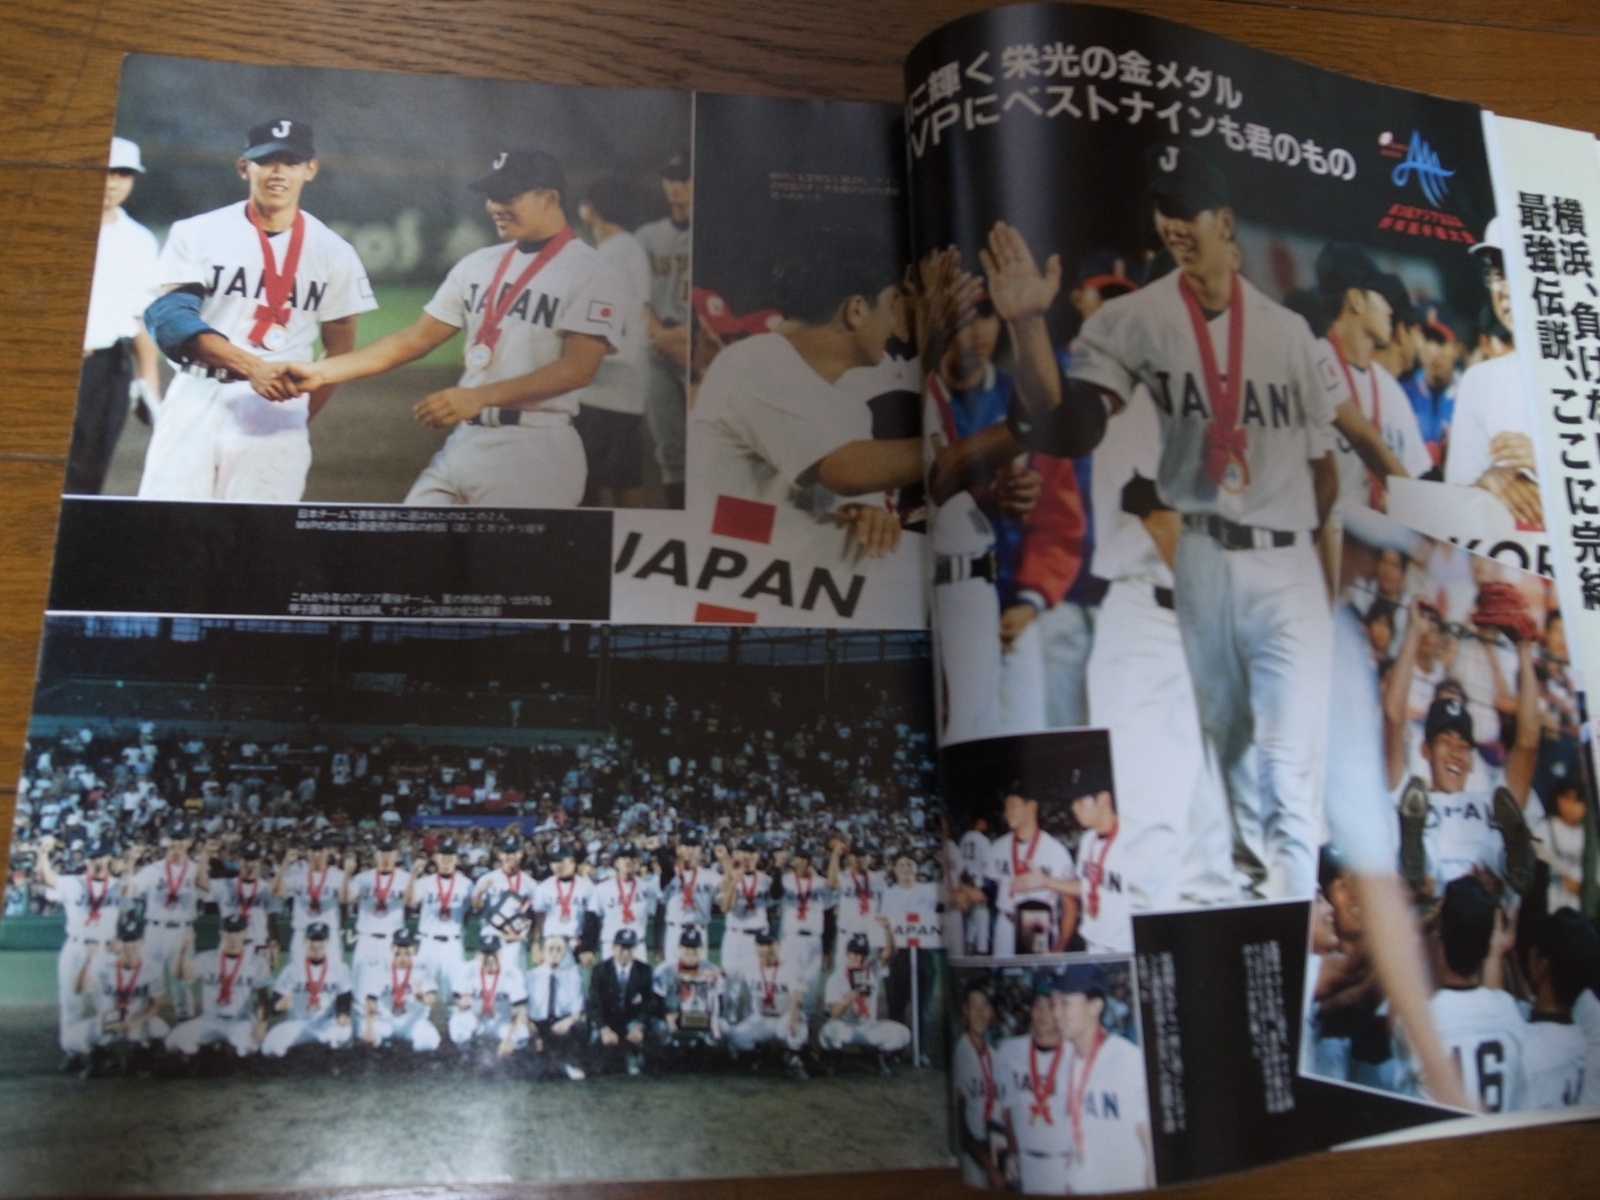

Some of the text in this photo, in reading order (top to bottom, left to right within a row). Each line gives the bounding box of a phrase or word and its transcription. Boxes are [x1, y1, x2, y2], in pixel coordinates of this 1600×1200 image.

[272, 120, 292, 138] J
[906, 84, 1358, 181] VPにベストナインも君のもの
[493, 152, 508, 170] J
[1158, 146, 1180, 172] J
[1154, 371, 1290, 428] JAAN
[614, 531, 866, 619] JAPAN
